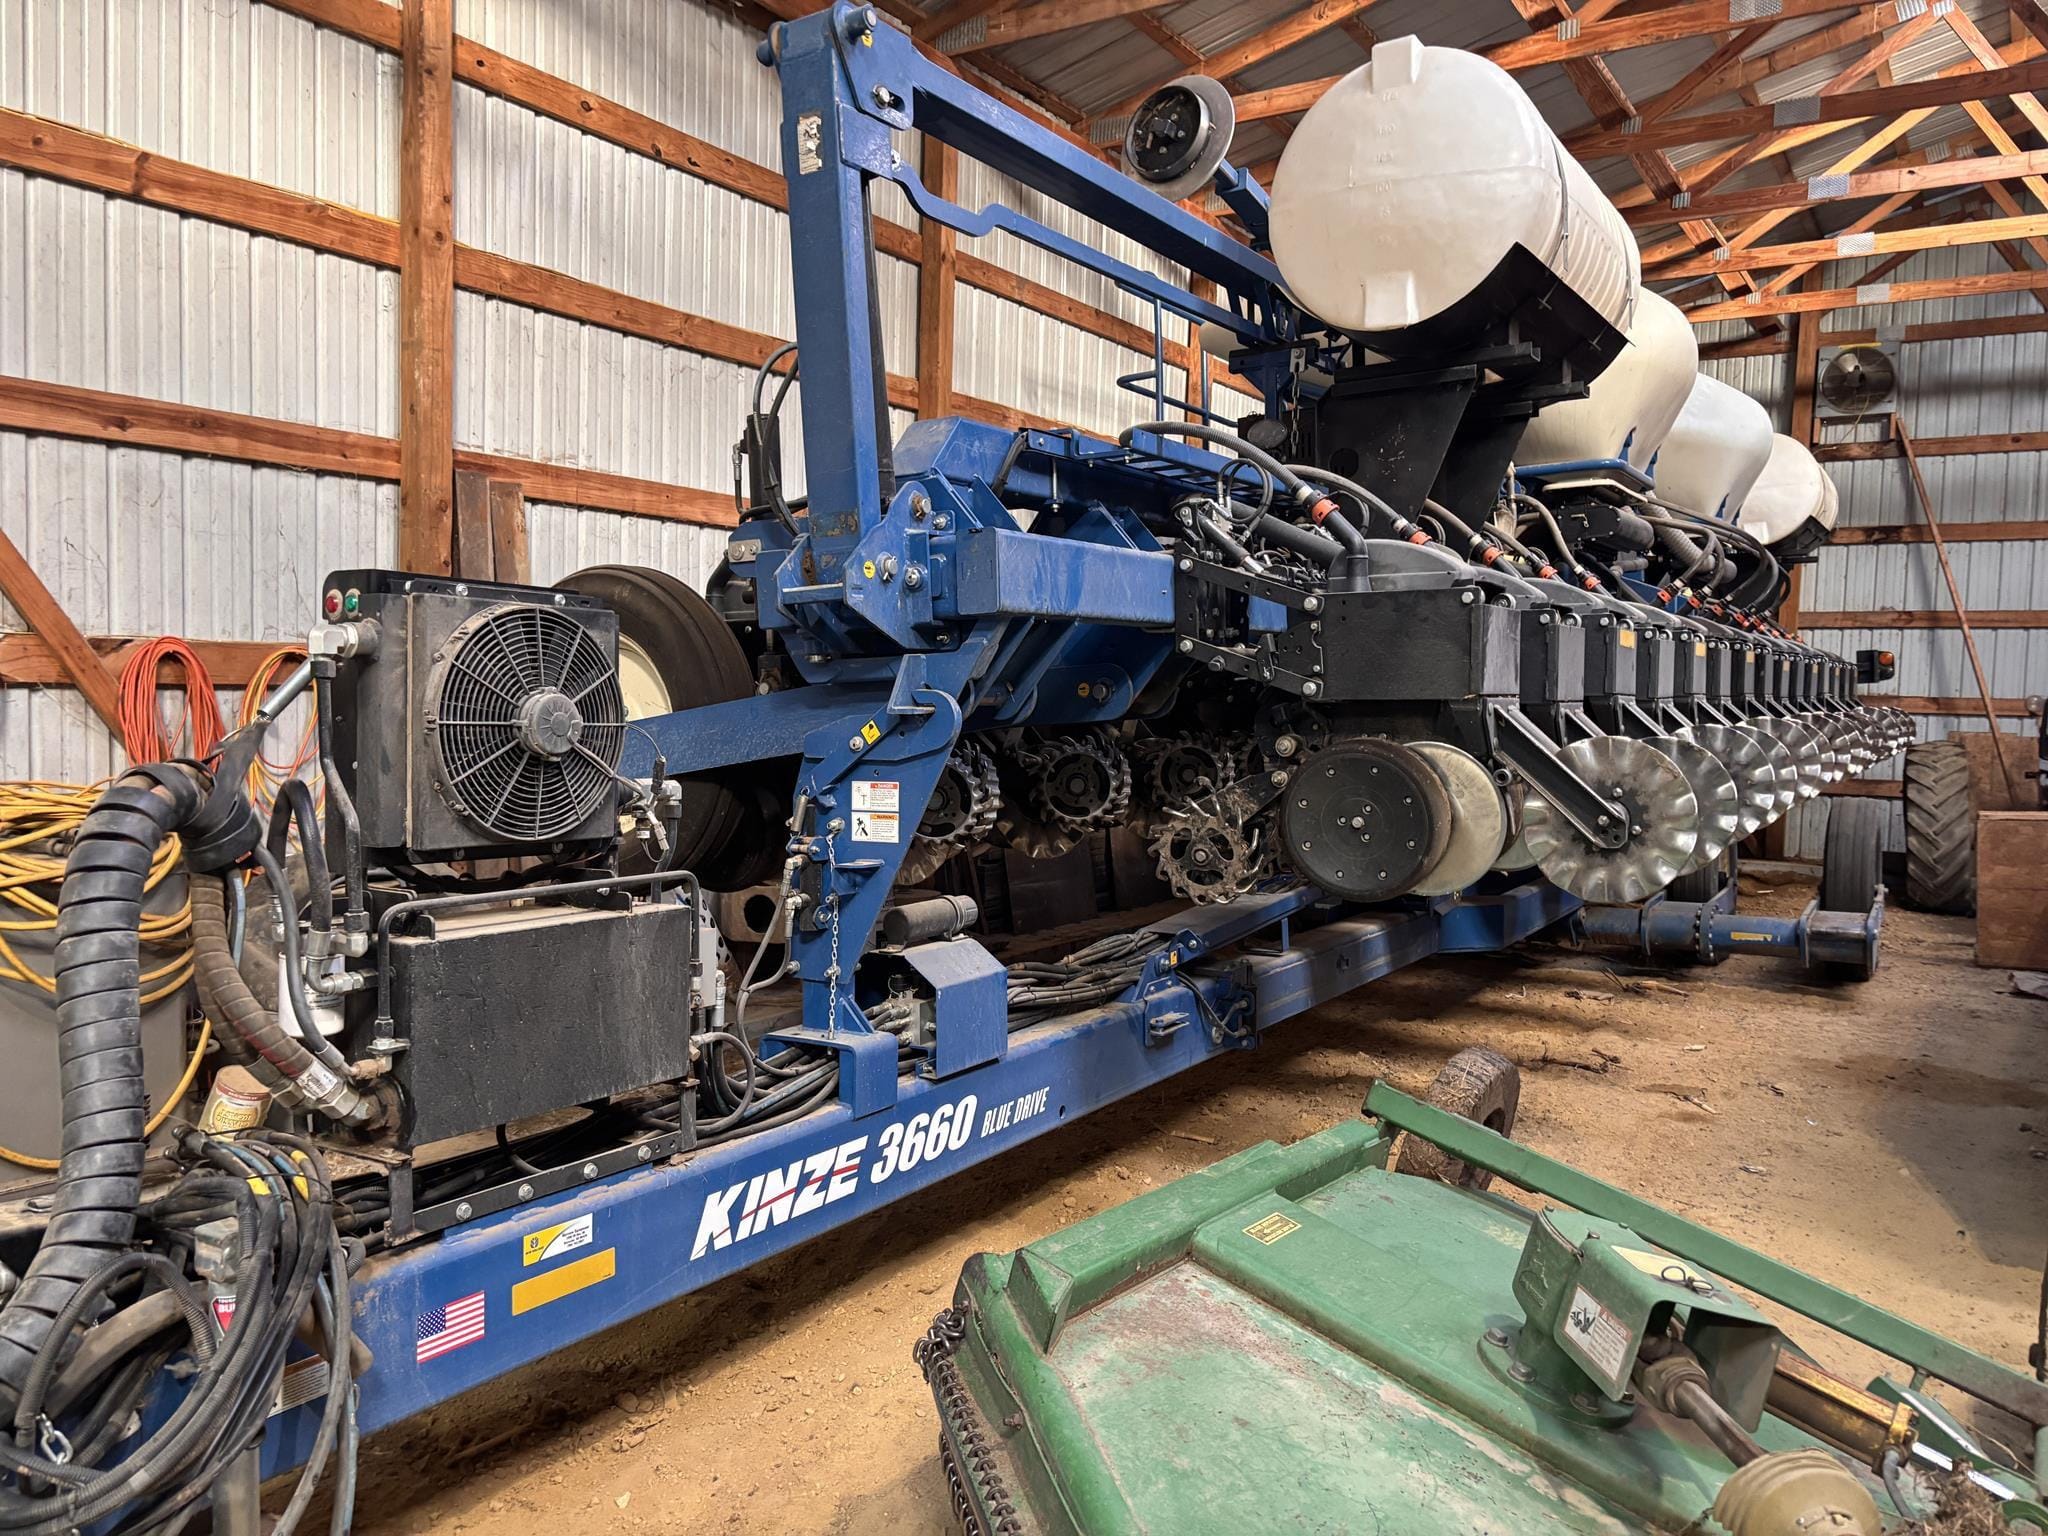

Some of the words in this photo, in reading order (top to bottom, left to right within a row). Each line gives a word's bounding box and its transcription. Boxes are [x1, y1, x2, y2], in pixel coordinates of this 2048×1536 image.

[689, 1134, 869, 1261] KINZE
[870, 1095, 978, 1184] 3660
[980, 1104, 1016, 1139] BLUE
[1013, 1086, 1051, 1122] DRIVE
